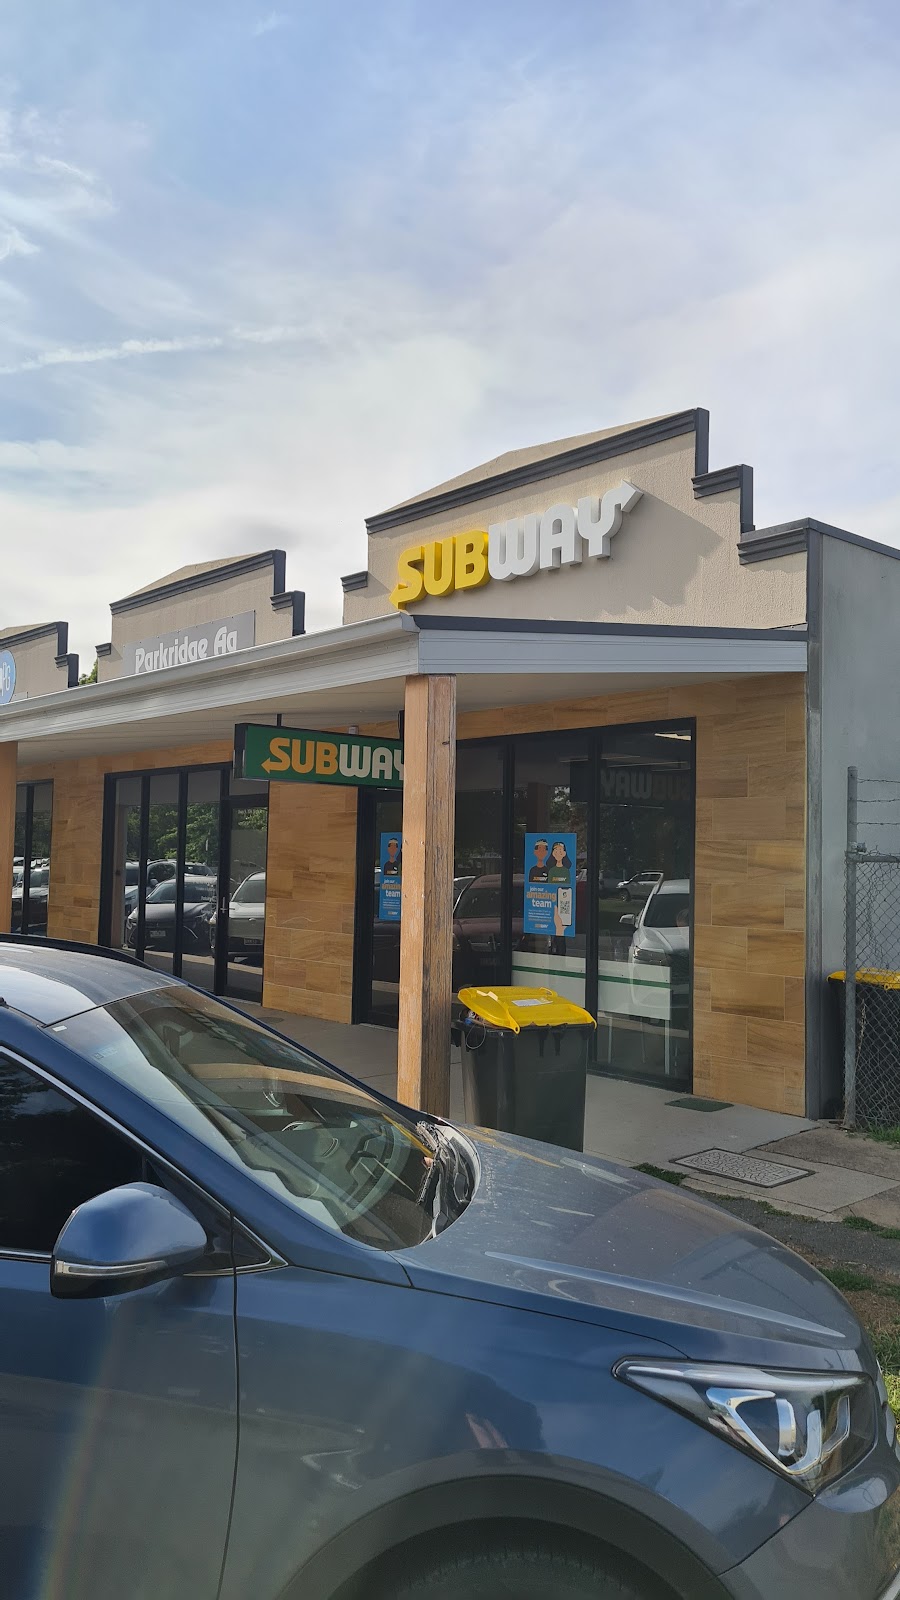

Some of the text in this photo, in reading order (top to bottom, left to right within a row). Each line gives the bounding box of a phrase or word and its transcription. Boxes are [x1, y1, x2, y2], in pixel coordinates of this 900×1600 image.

[389, 479, 644, 609] SUBWAY
[527, 891, 556, 902] amazing
[532, 899, 552, 908] team
